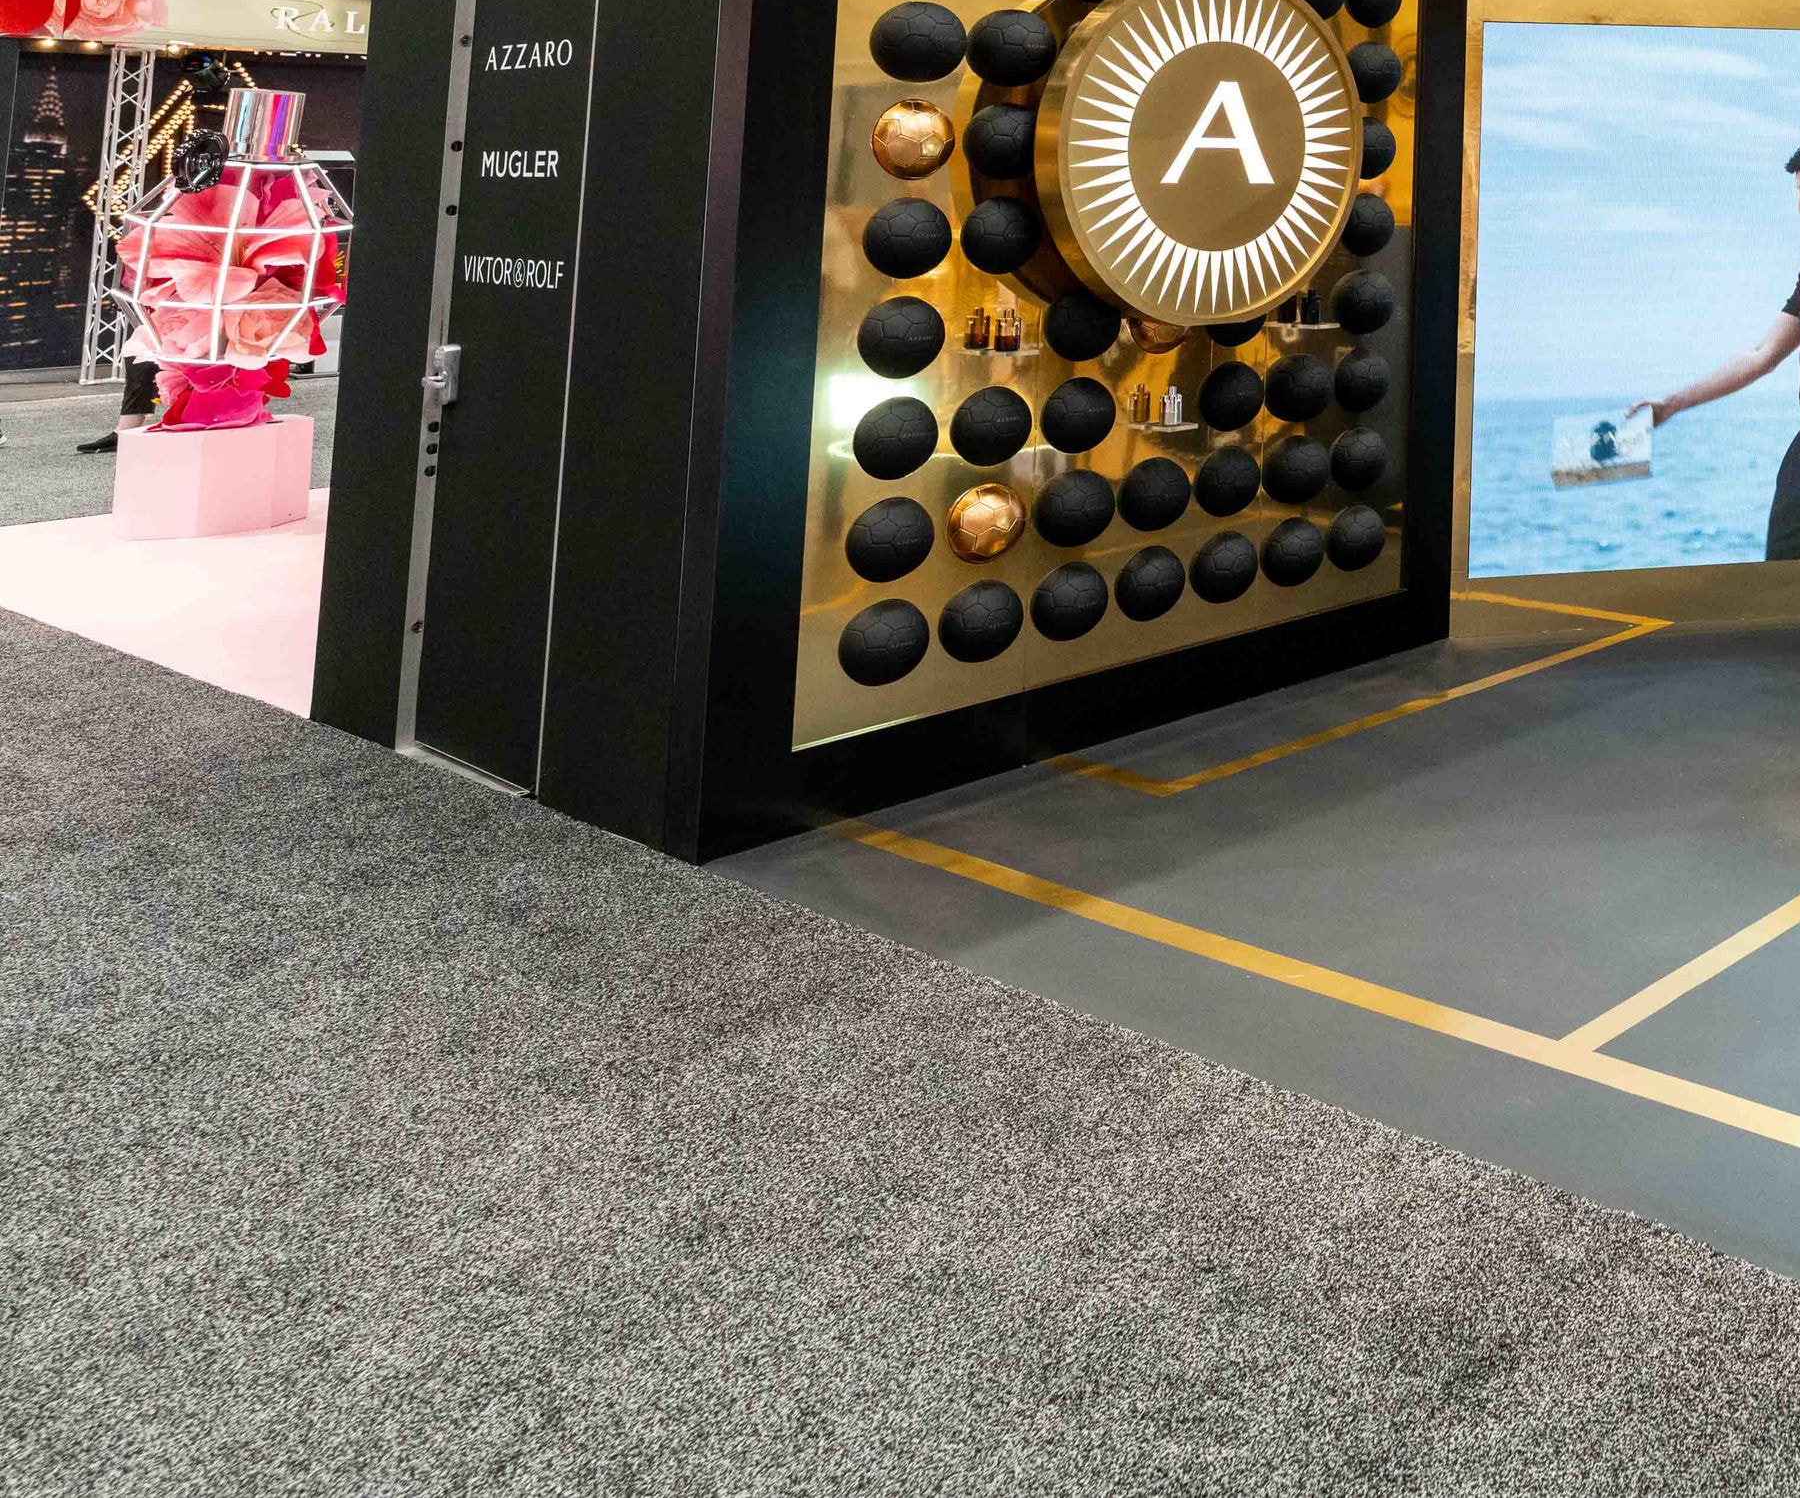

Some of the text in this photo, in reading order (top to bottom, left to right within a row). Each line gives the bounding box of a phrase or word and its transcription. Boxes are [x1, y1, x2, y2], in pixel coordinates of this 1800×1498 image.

[273, 6, 366, 35] RAL
[484, 38, 574, 72] AZZARO
[1159, 80, 1276, 185] A
[481, 150, 559, 178] MUGLER
[463, 255, 565, 290] VIKTOR&ROLF
